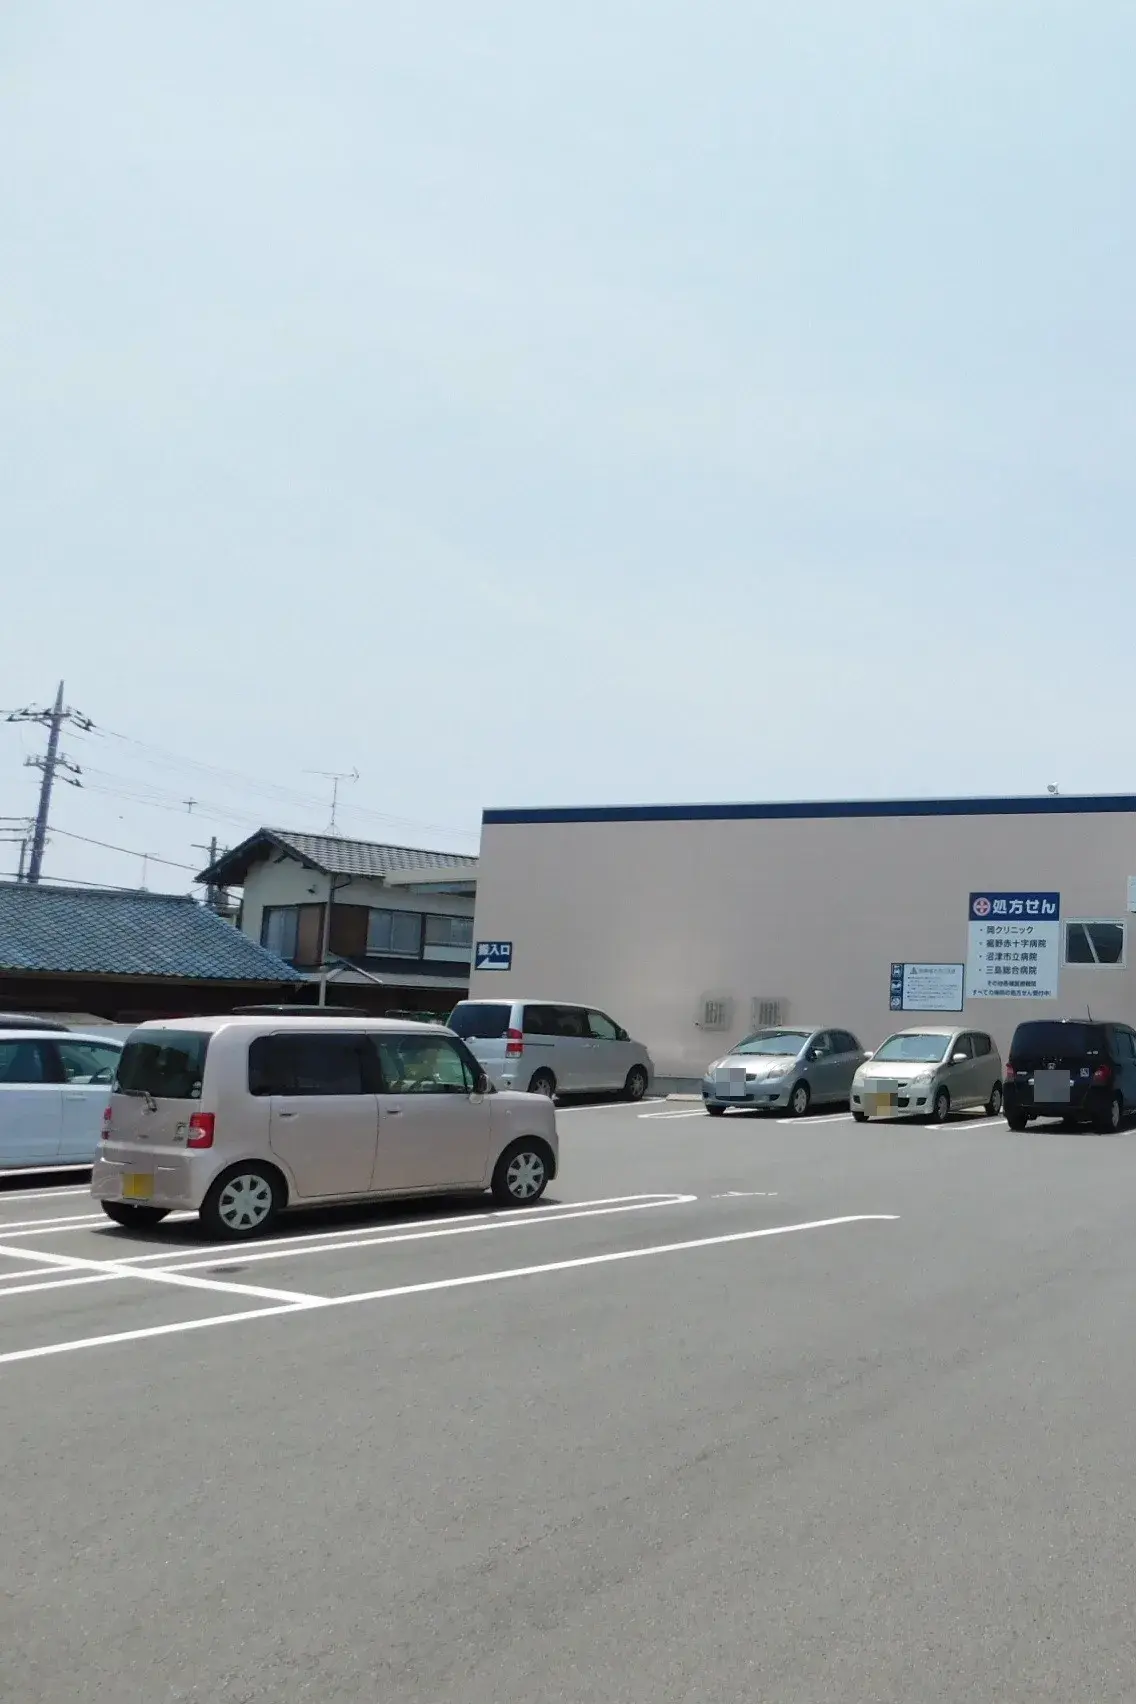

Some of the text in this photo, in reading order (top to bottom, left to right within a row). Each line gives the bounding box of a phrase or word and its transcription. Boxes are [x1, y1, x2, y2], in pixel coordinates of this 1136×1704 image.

[992, 899, 1056, 914] 処方せん
[985, 952, 1038, 961] 沼津市立病院
[985, 966, 1038, 975] 三島総合病院
